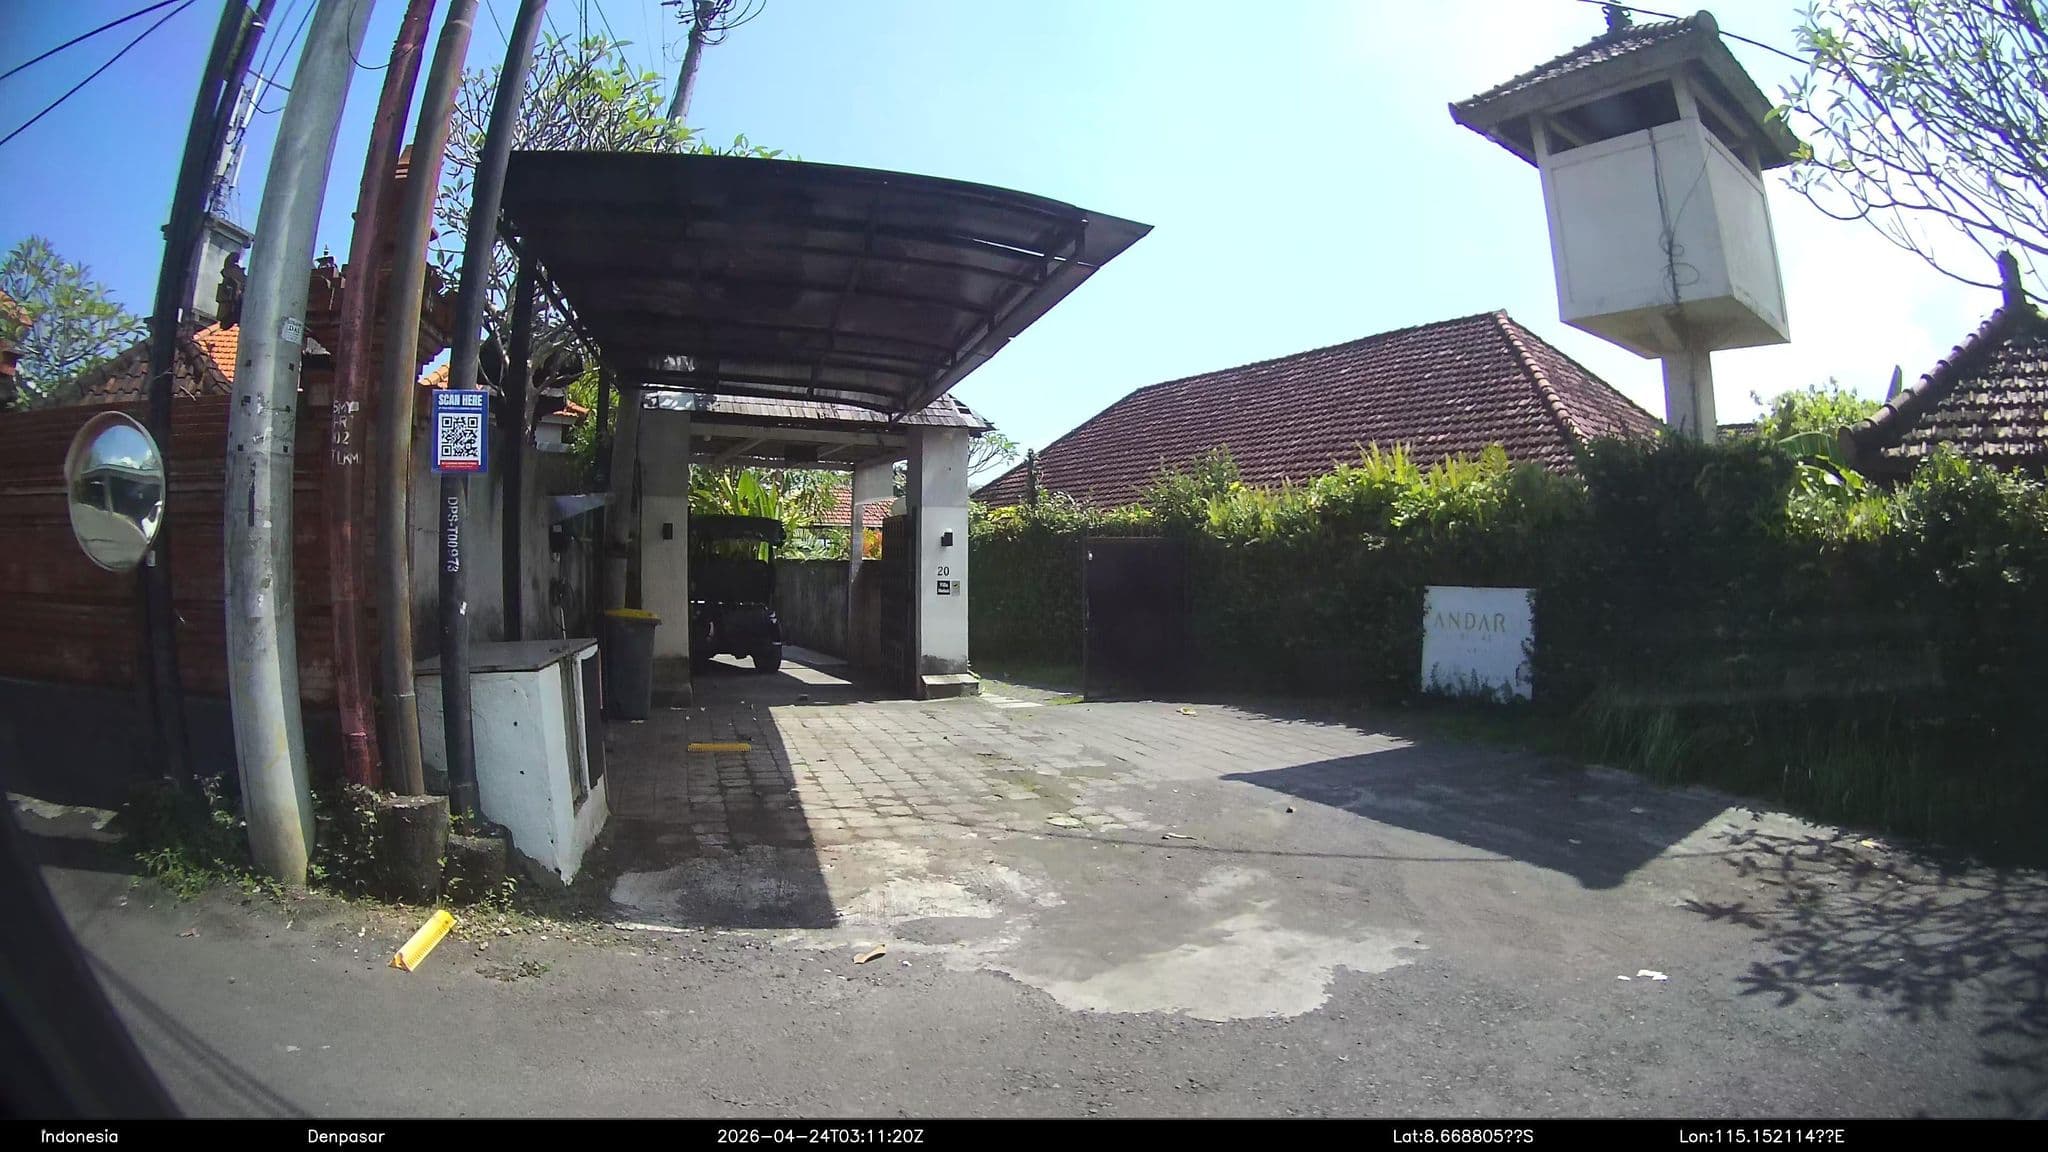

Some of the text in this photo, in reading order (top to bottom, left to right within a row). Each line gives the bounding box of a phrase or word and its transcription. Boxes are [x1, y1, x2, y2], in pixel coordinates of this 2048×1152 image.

[438, 394, 483, 406] SCAN HERE
[447, 496, 459, 572] DPS-T00973
[937, 566, 950, 576] 20
